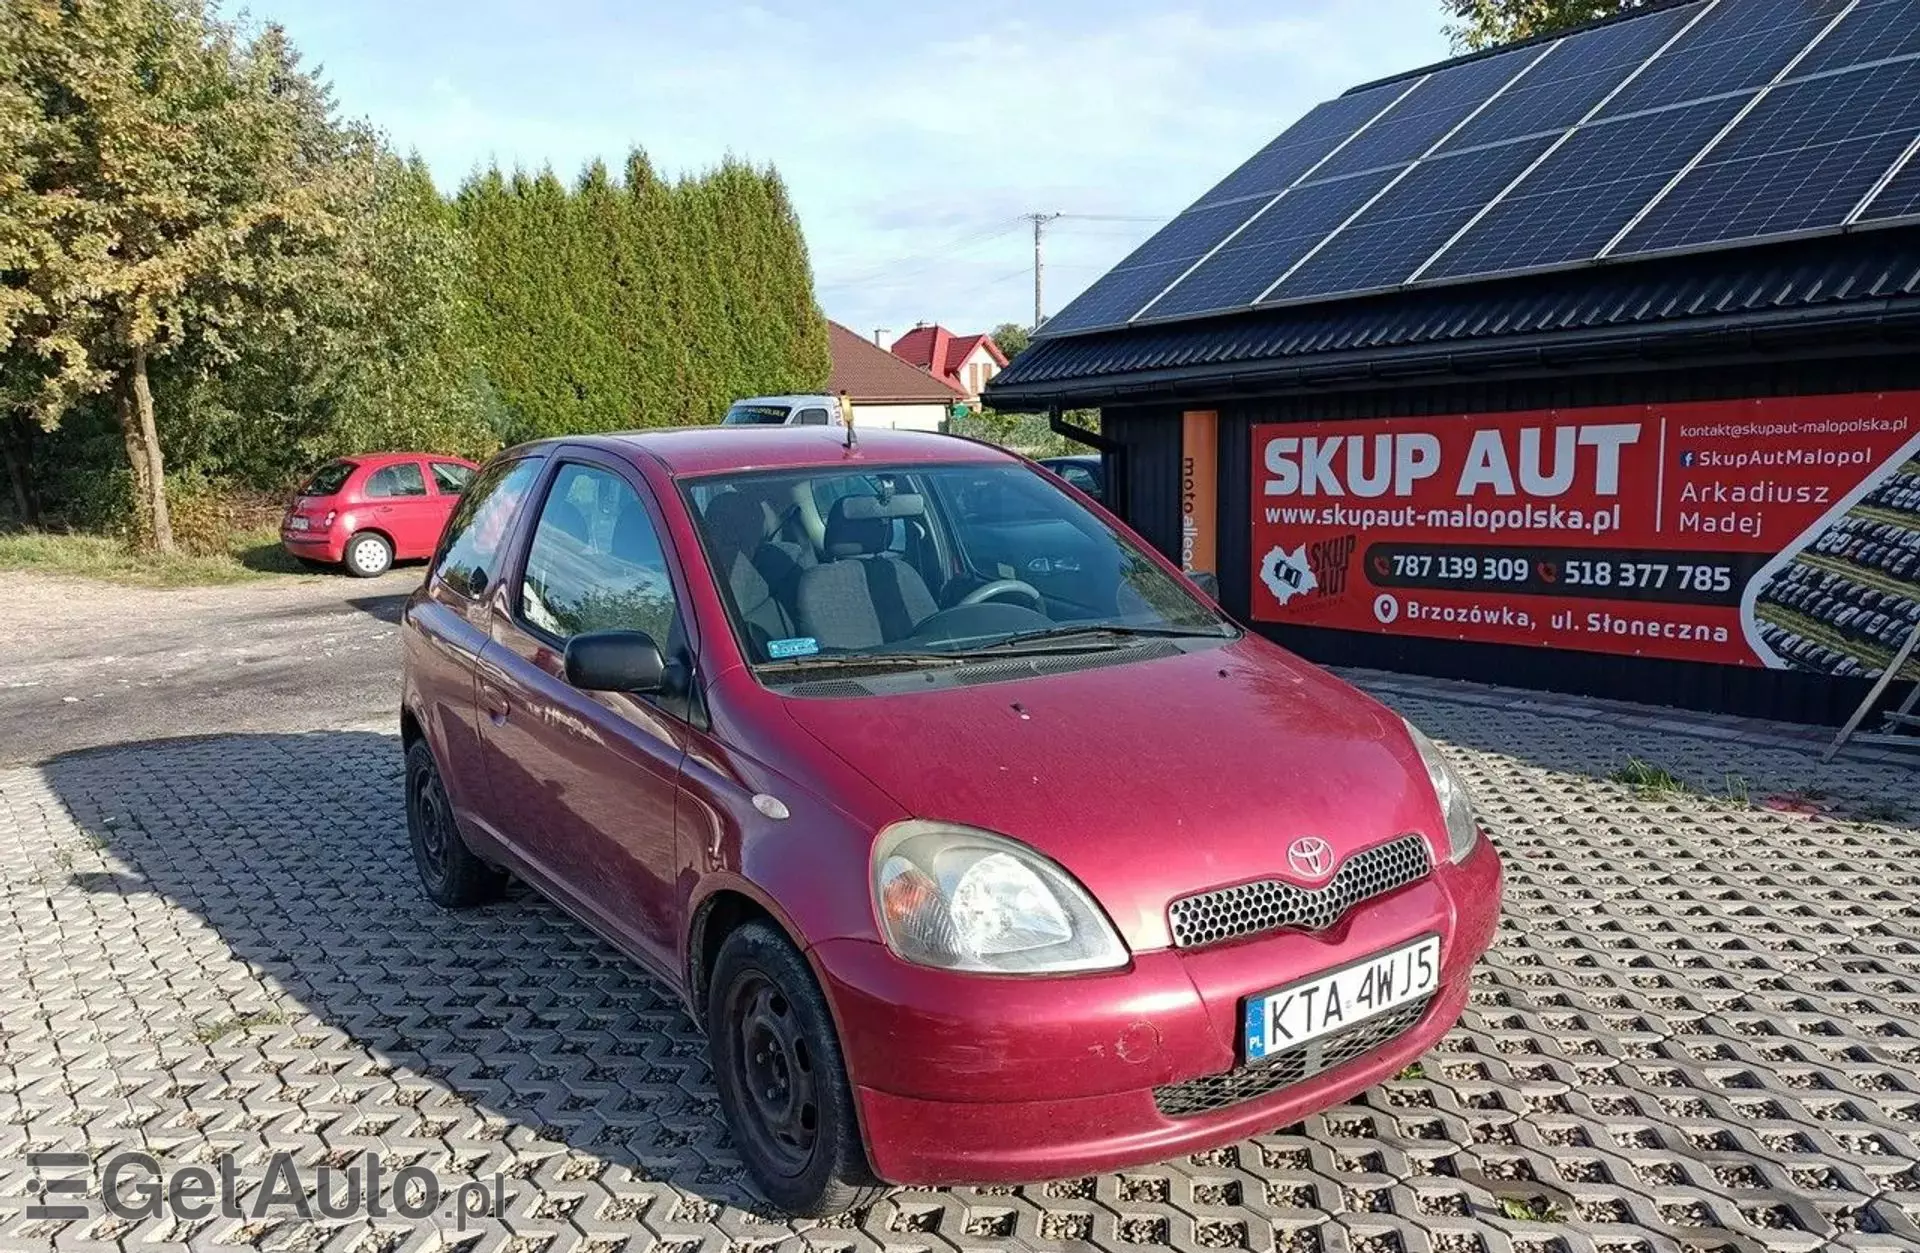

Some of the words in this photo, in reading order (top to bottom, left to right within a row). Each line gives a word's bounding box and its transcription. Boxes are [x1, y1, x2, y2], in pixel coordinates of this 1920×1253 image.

[1680, 417, 1908, 438] kontakt@skupaut-malopolska.pl
[1263, 432, 1442, 498] SKUP
[1455, 422, 1642, 497] AUT
[1700, 448, 1872, 468] SkupAutMalopol
[1680, 480, 1830, 503] Arkadiusz
[1265, 503, 1621, 535] www.skupaut-malopolska.pl
[1679, 511, 1762, 537] Madej
[1311, 534, 1357, 573] SKUP
[1317, 567, 1346, 598] AUT
[1393, 555, 1432, 578] 787
[1438, 556, 1478, 580] 139
[1483, 557, 1529, 582] 309
[1565, 560, 1612, 586] 518
[1618, 562, 1669, 589] 377
[1676, 565, 1731, 592] 785
[1406, 601, 1537, 631] Brzozówka,
[1551, 610, 1580, 631] ul.
[1587, 613, 1729, 643] Słoneczna
[1271, 981, 1343, 1045] KTA
[1356, 944, 1433, 1011] 4WJ5
[1249, 1035, 1263, 1048] PL
